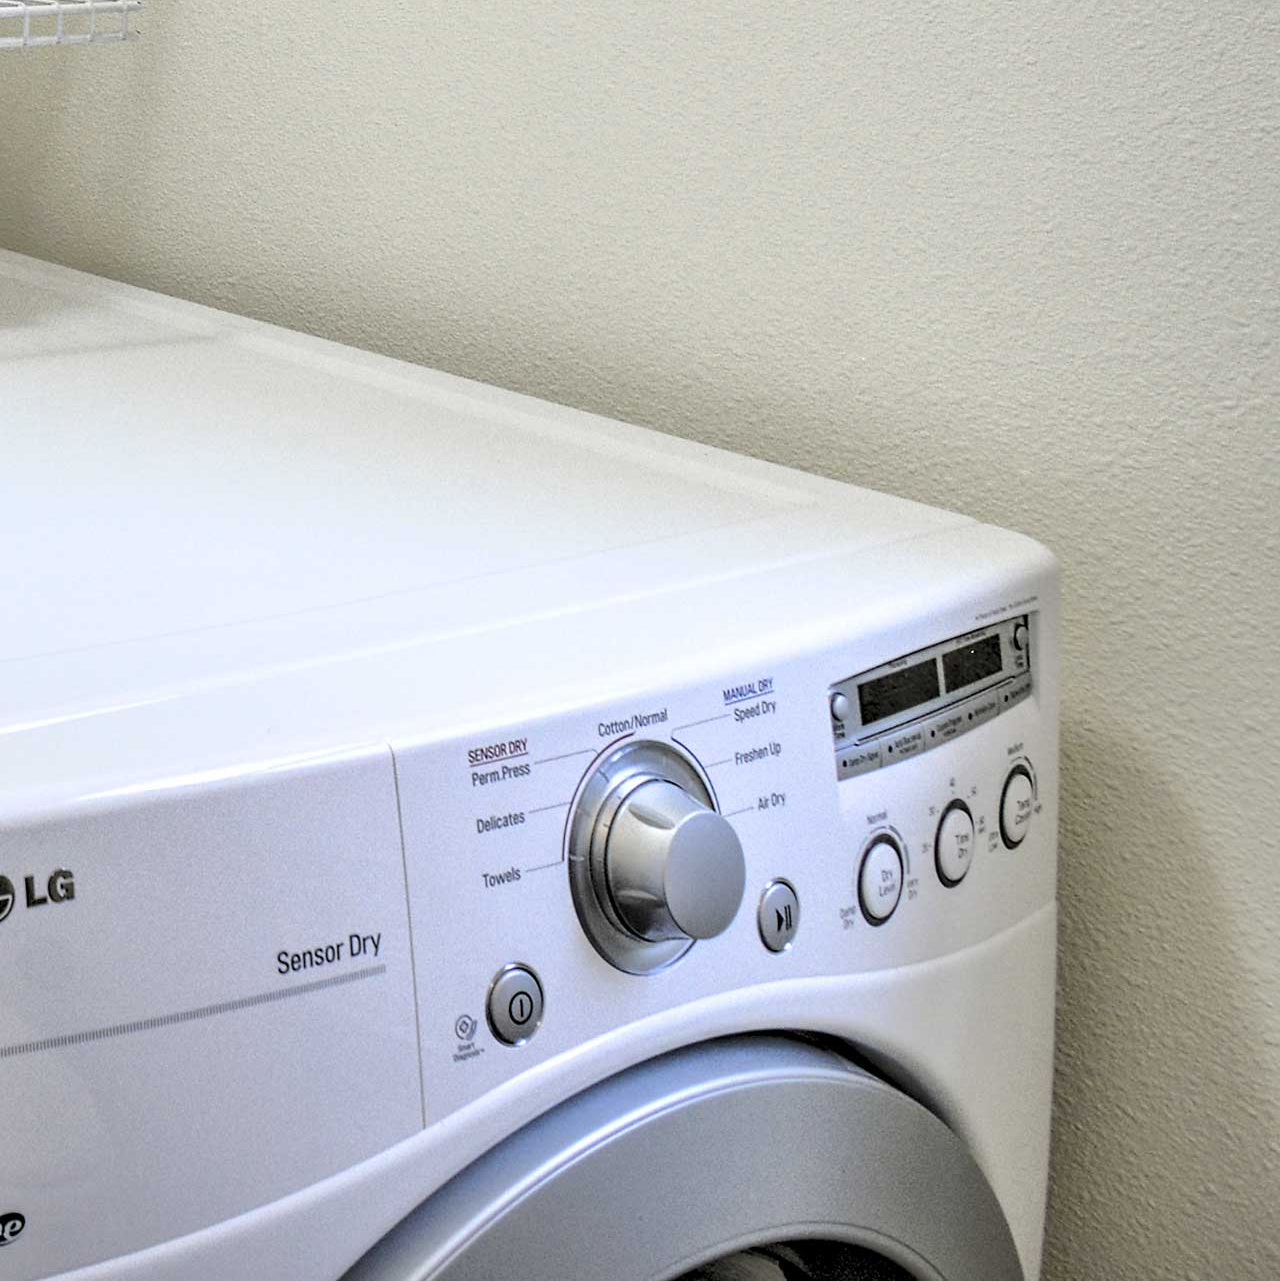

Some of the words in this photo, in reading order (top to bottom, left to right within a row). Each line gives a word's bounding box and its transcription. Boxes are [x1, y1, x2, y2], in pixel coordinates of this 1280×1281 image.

[598, 707, 668, 738] Cotton/Normal
[733, 703, 759, 723] Speed
[760, 699, 777, 717] Dry
[467, 743, 506, 765] SENSOR
[506, 737, 529, 756] DRY
[734, 744, 768, 766] Freshen
[769, 740, 782, 758] Up
[758, 795, 770, 812] Air
[770, 790, 787, 808] Dry
[476, 810, 526, 835] Delicates
[23, 868, 76, 908] LG
[483, 866, 522, 889] Towels
[276, 939, 345, 976] Sensor
[348, 931, 382, 961] Dry
